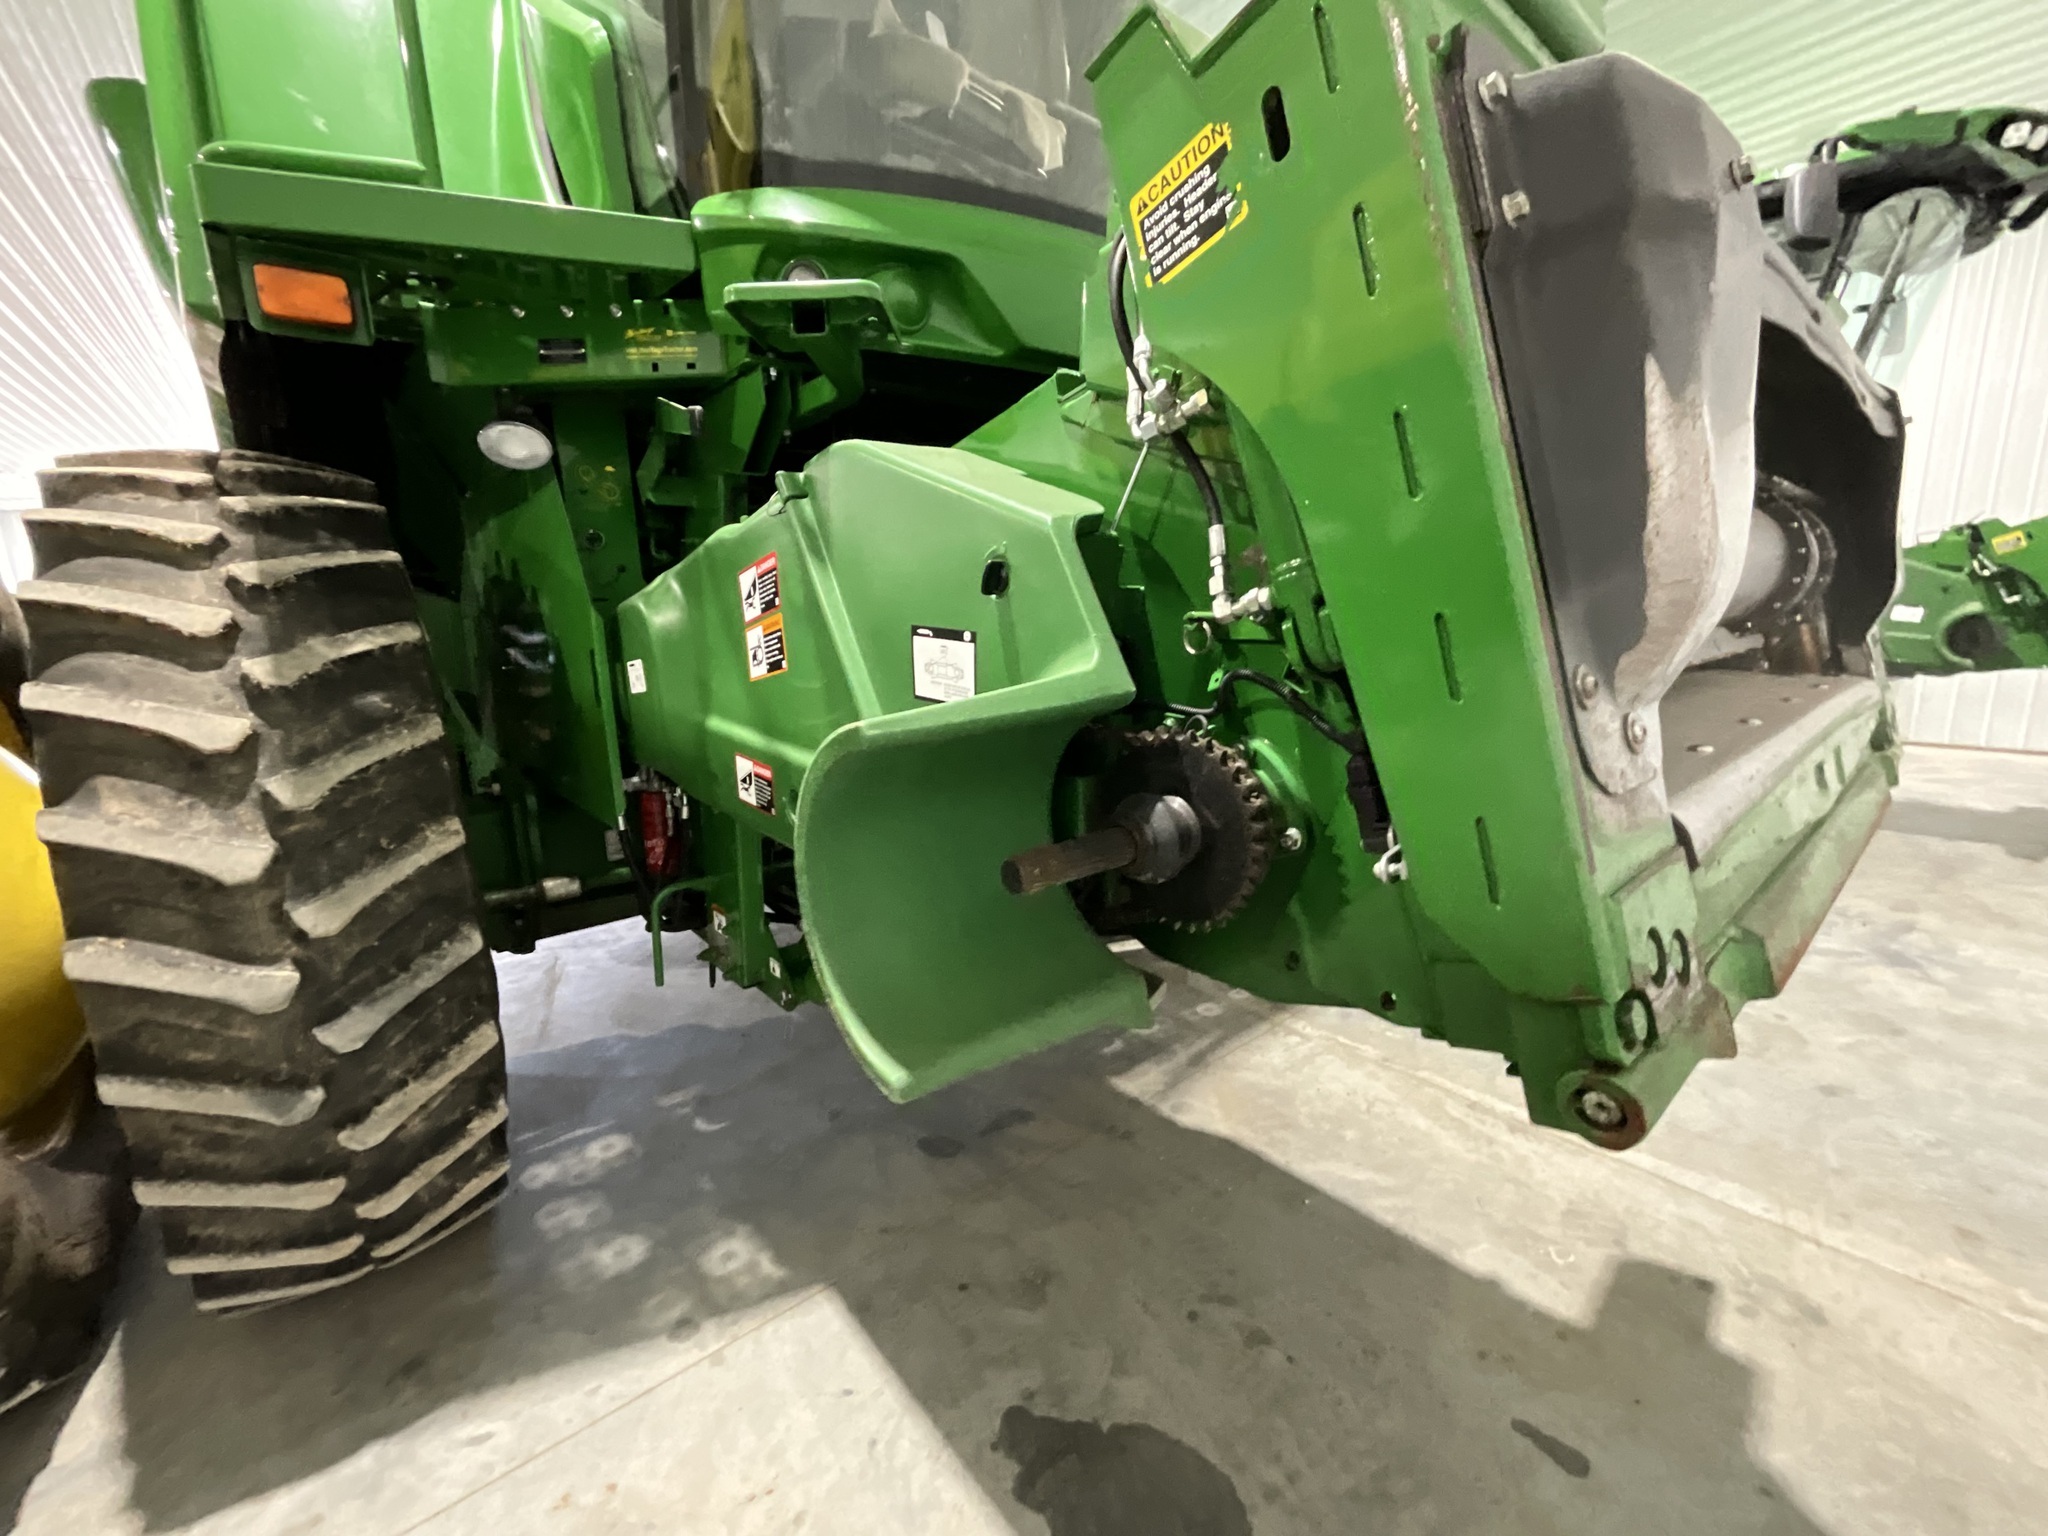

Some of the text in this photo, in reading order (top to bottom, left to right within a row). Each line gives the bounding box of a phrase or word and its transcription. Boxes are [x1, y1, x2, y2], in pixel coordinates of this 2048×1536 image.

[1148, 124, 1224, 202] CAUTION
[1143, 164, 1211, 230] Avoid crushing
[1145, 172, 1218, 242] injuries. Header
[1148, 199, 1204, 254] can tilt. Stay
[1150, 242, 1172, 265] clear
[1172, 220, 1198, 246] when
[1153, 234, 1200, 277] is running.
